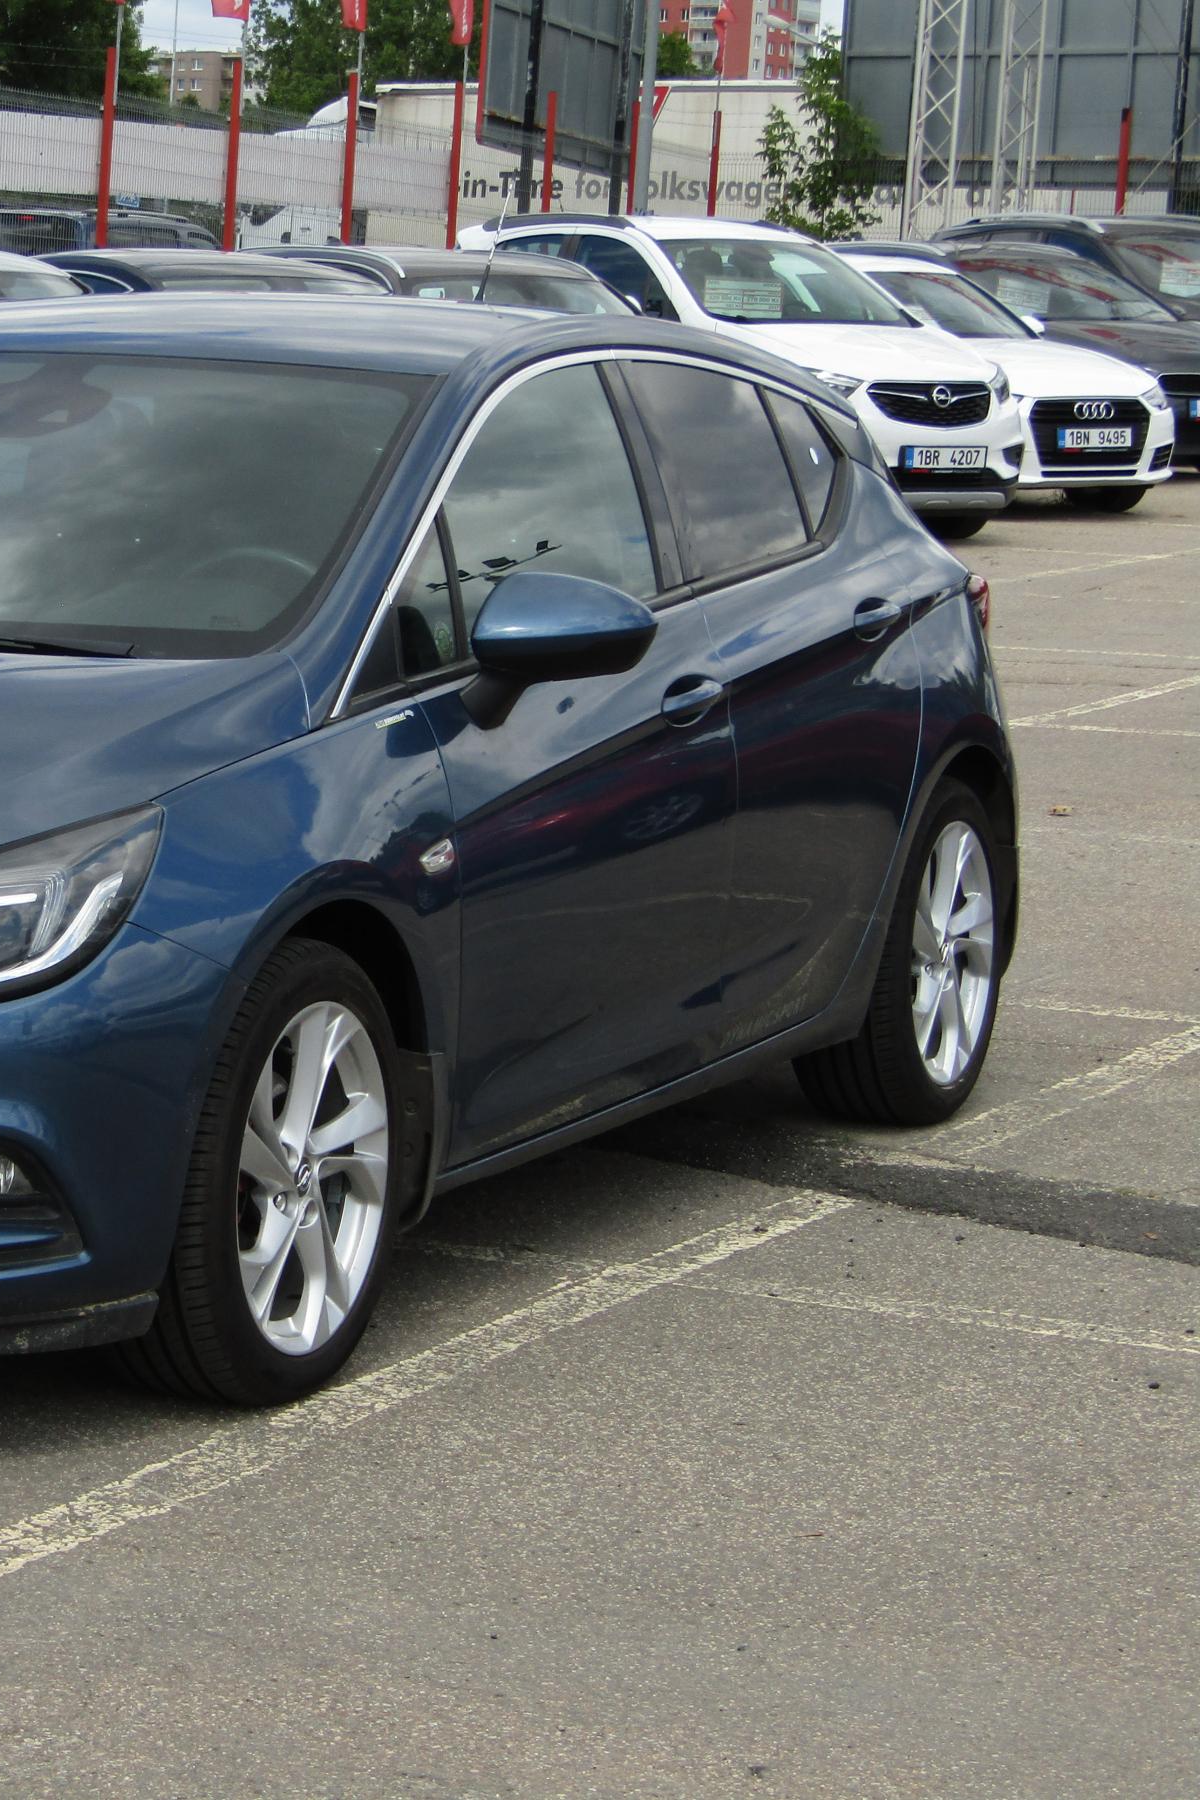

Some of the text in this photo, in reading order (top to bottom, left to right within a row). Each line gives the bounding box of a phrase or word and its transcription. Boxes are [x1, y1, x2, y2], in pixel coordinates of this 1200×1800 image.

[1069, 430, 1126, 446] 1BN 9495
[917, 450, 980, 466] 1BR 4207
